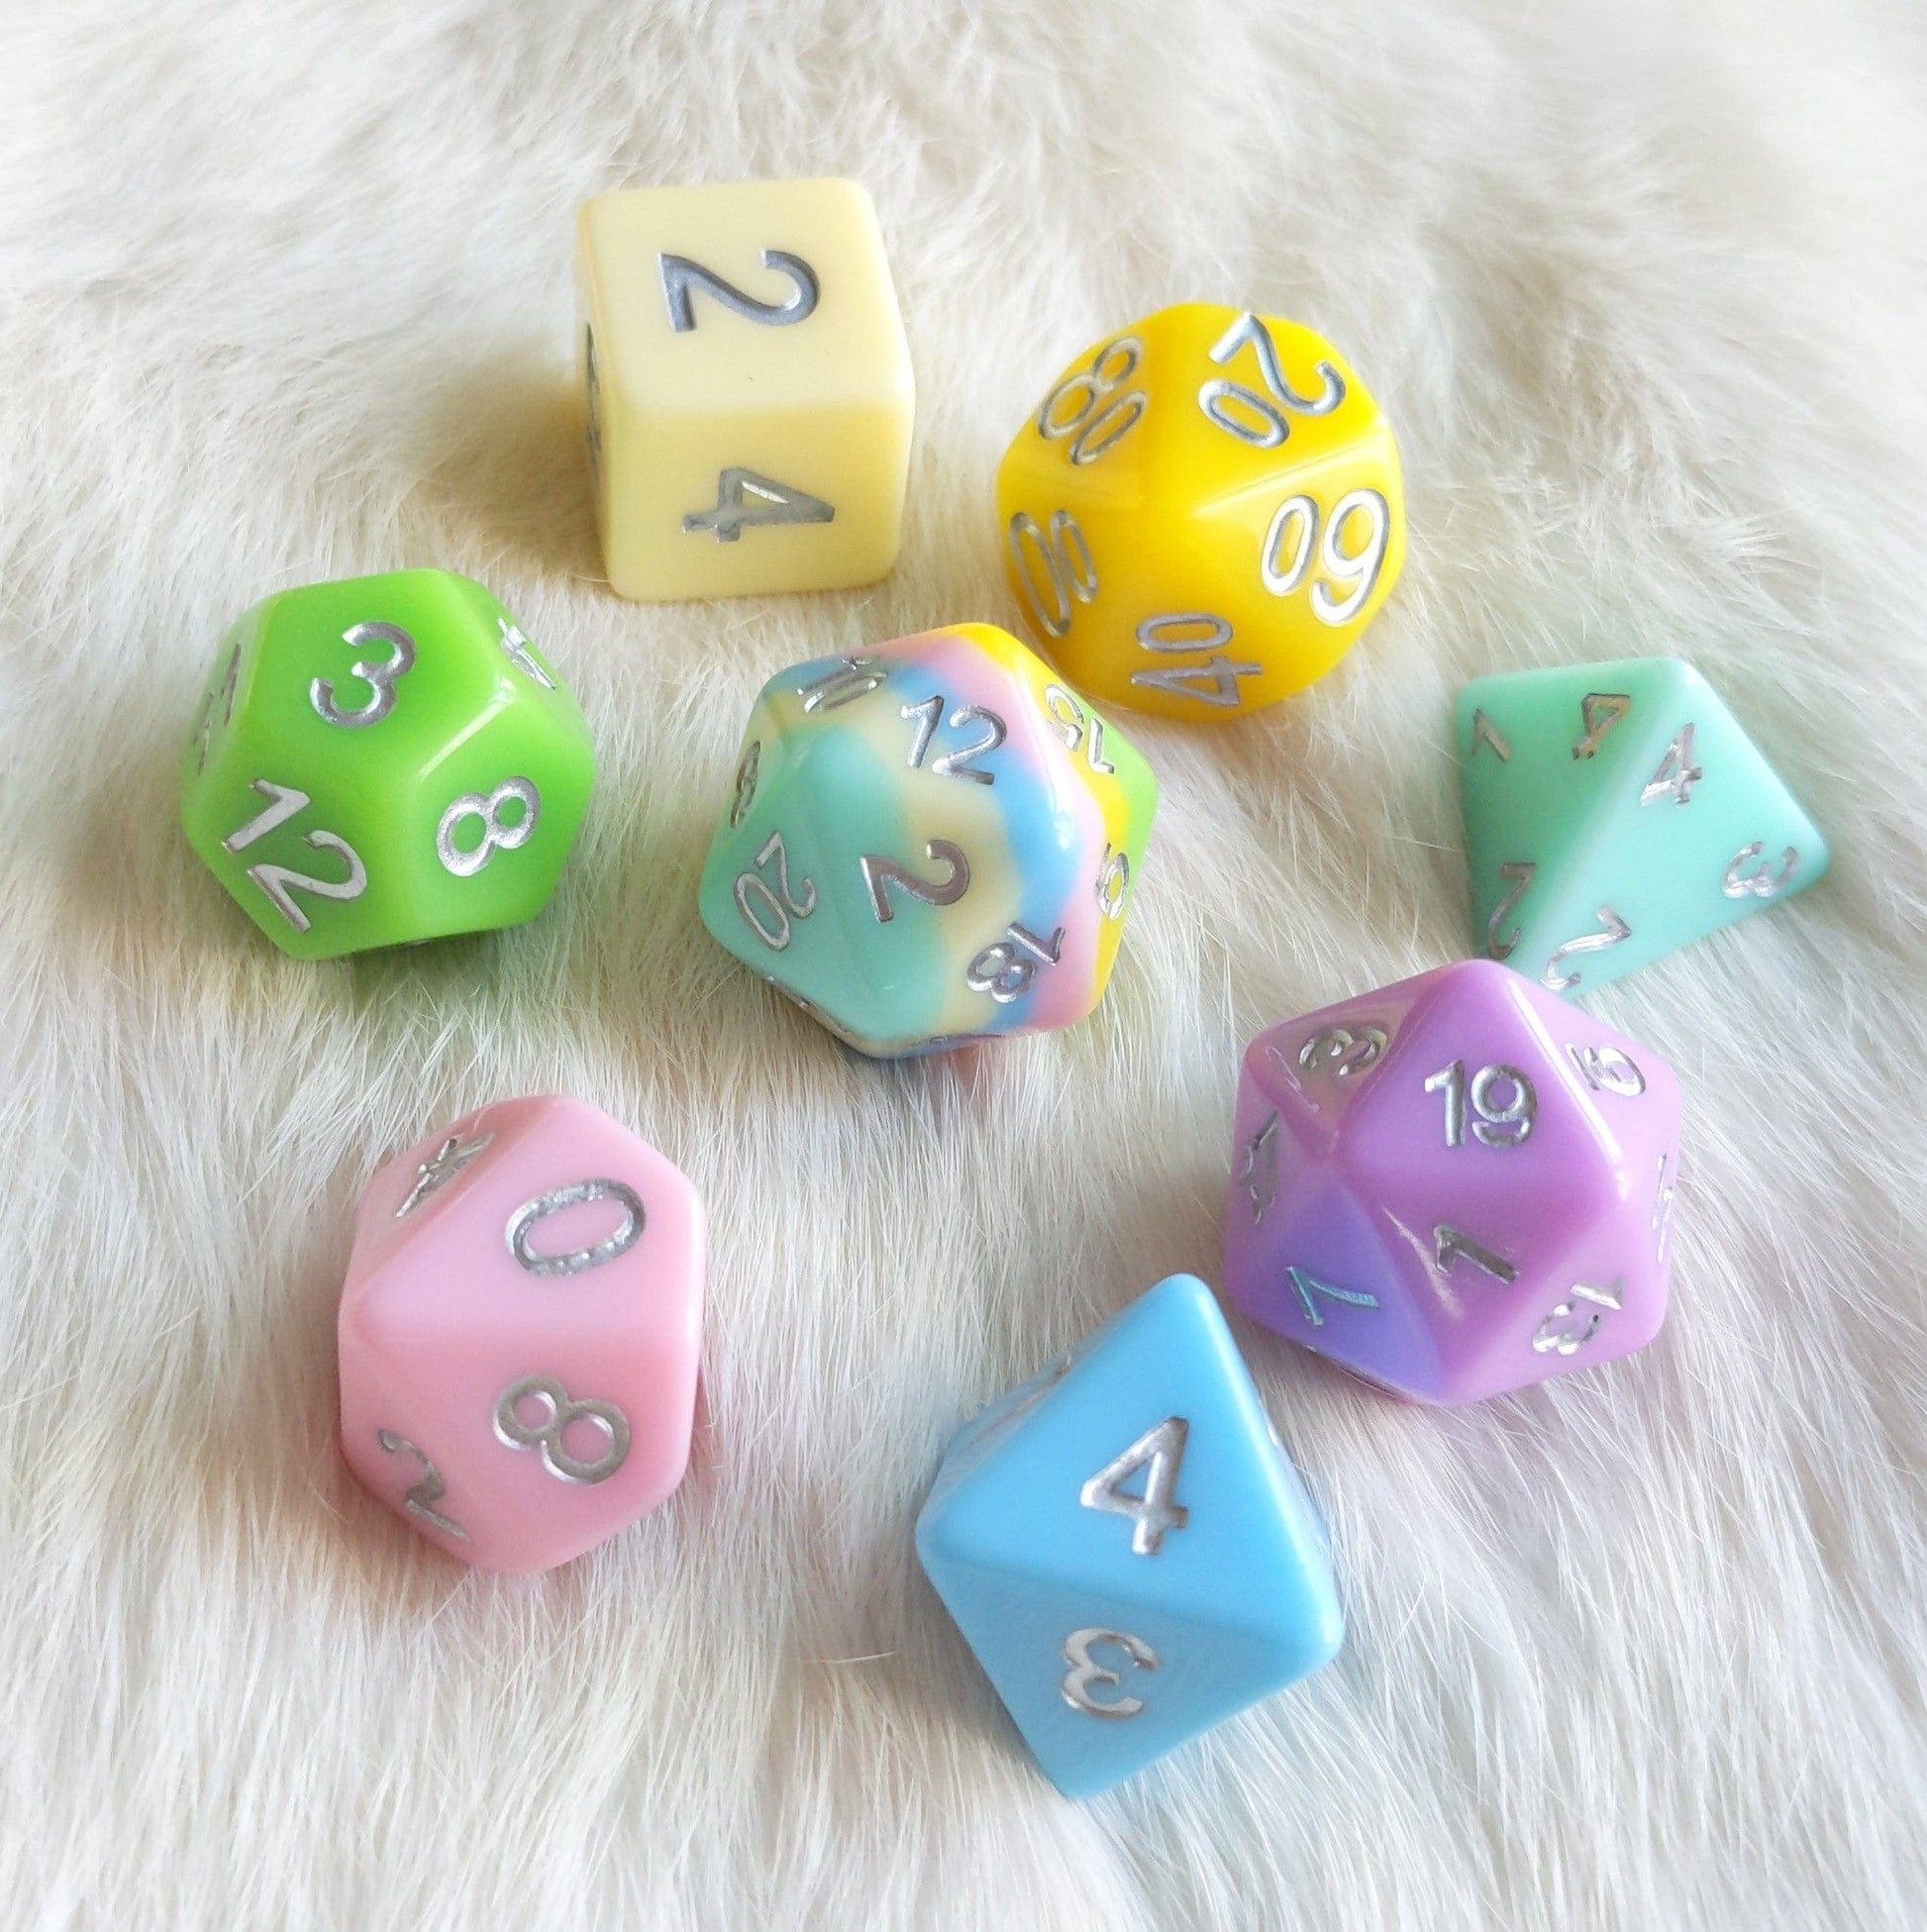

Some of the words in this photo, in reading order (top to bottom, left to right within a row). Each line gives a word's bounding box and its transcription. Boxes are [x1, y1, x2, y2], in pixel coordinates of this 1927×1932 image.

[658, 248, 821, 333] 2
[1038, 337, 1149, 465] 80
[1198, 312, 1346, 448] 20
[682, 466, 835, 543] 4
[1010, 509, 1098, 637] 00
[309, 621, 417, 729] 3
[1131, 612, 1262, 707] 40
[900, 695, 1007, 786] 12
[1045, 683, 1115, 774] 15
[1572, 692, 1632, 760] 4
[1640, 722, 1702, 807] 4
[221, 777, 368, 933] 12
[437, 774, 541, 877] 8
[1722, 841, 1799, 898] 3
[734, 831, 817, 952] 20
[860, 839, 970, 923] 2
[1487, 862, 1536, 961] 2
[967, 921, 1065, 1003] 18
[1540, 903, 1632, 991] 2
[1424, 1060, 1538, 1149] 19
[504, 1178, 646, 1276] 0
[1432, 1224, 1520, 1285] 1
[1532, 1275, 1628, 1356] 13
[491, 1374, 632, 1484] 8
[377, 1428, 471, 1542] 2
[1079, 1415, 1189, 1556] 4
[1061, 1627, 1159, 1718] 3
